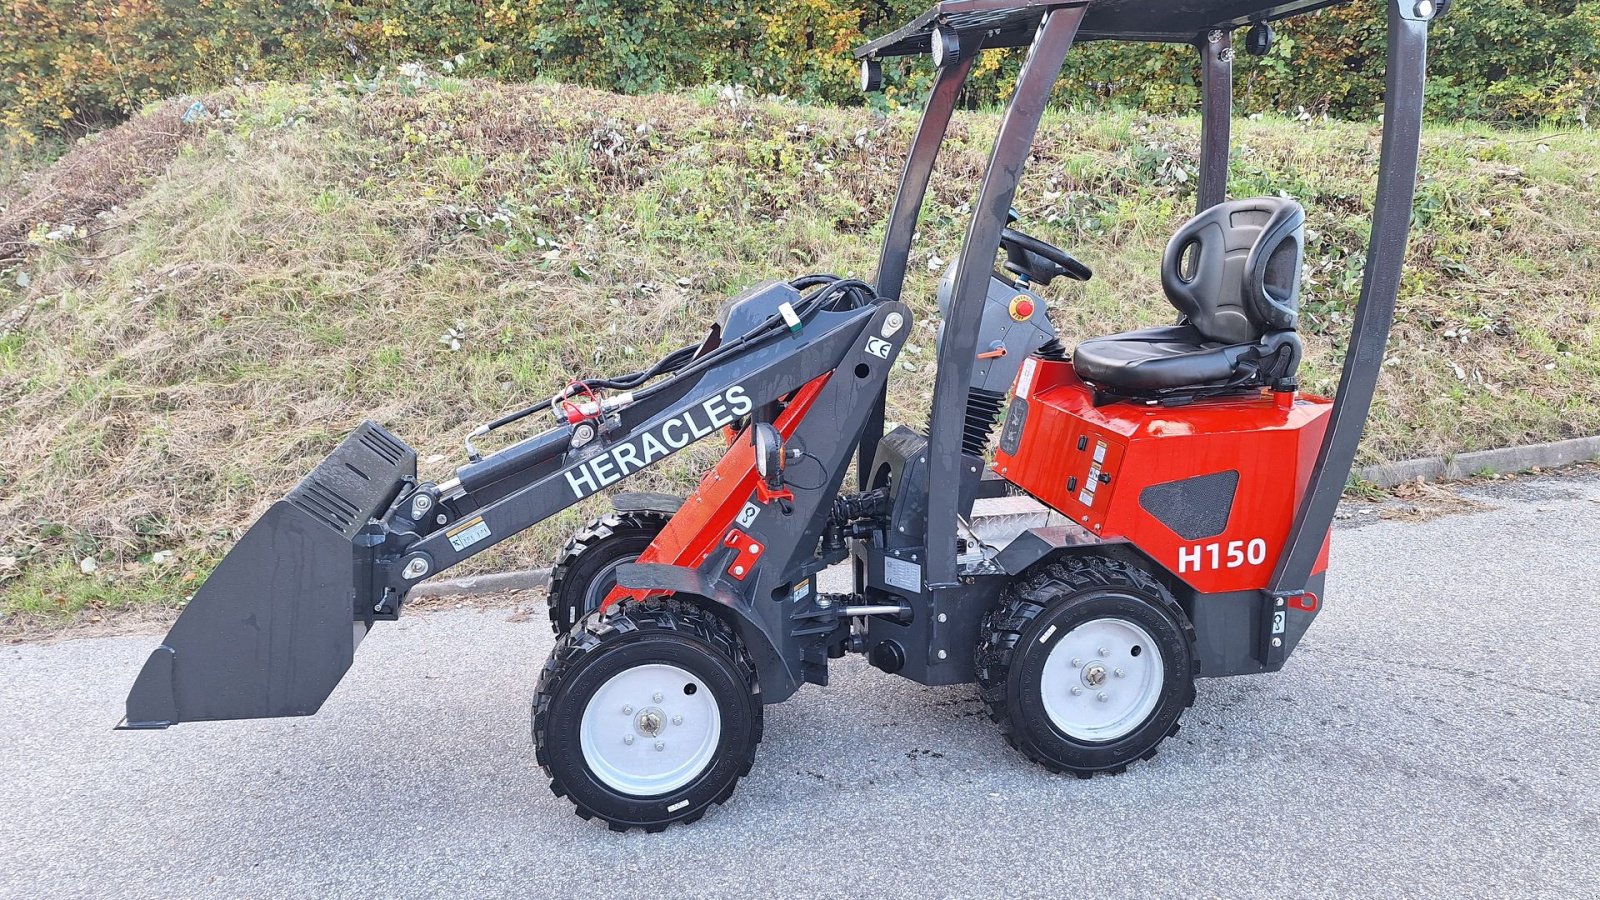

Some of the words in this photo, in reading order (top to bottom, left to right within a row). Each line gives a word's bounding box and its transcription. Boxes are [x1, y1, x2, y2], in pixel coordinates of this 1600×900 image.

[868, 339, 891, 358] CE
[564, 385, 752, 499] HERACLES
[1178, 538, 1267, 573] H150
